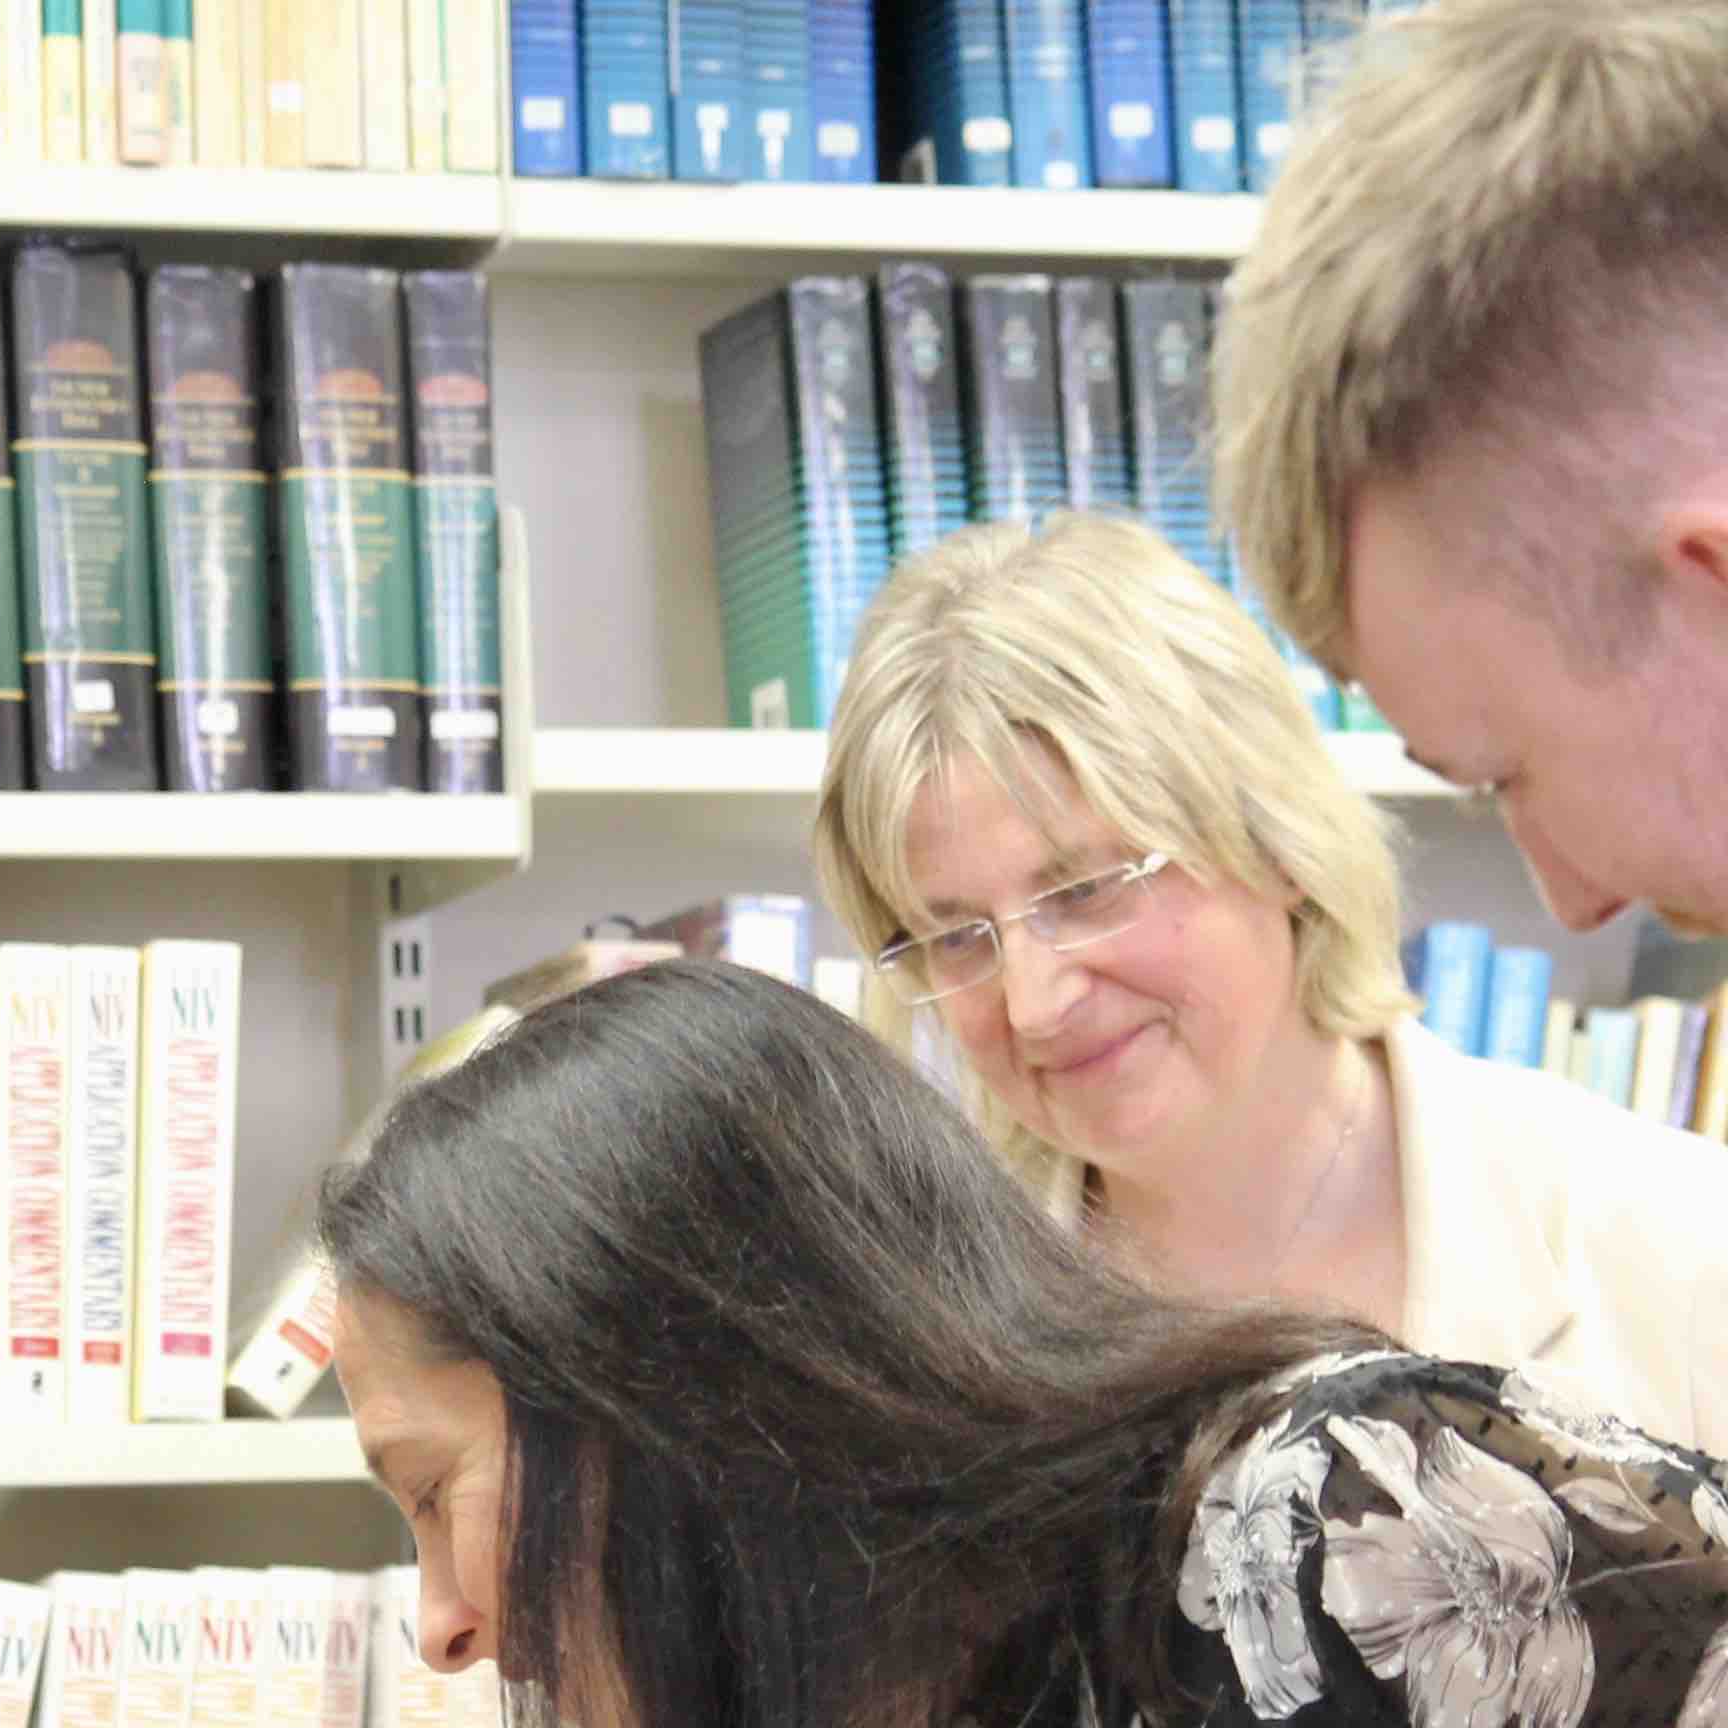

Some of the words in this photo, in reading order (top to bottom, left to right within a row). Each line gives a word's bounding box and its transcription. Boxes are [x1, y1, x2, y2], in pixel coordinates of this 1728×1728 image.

[90, 992, 127, 1038] NIV
[170, 986, 217, 1031] NIV
[82, 1043, 127, 1179] APPLICATION
[81, 1188, 126, 1332] COMMENTARY
[67, 1624, 114, 1672] NIV
[134, 1618, 184, 1666] NIV
[199, 1615, 254, 1662] NIV
[275, 1618, 317, 1664] NIV
